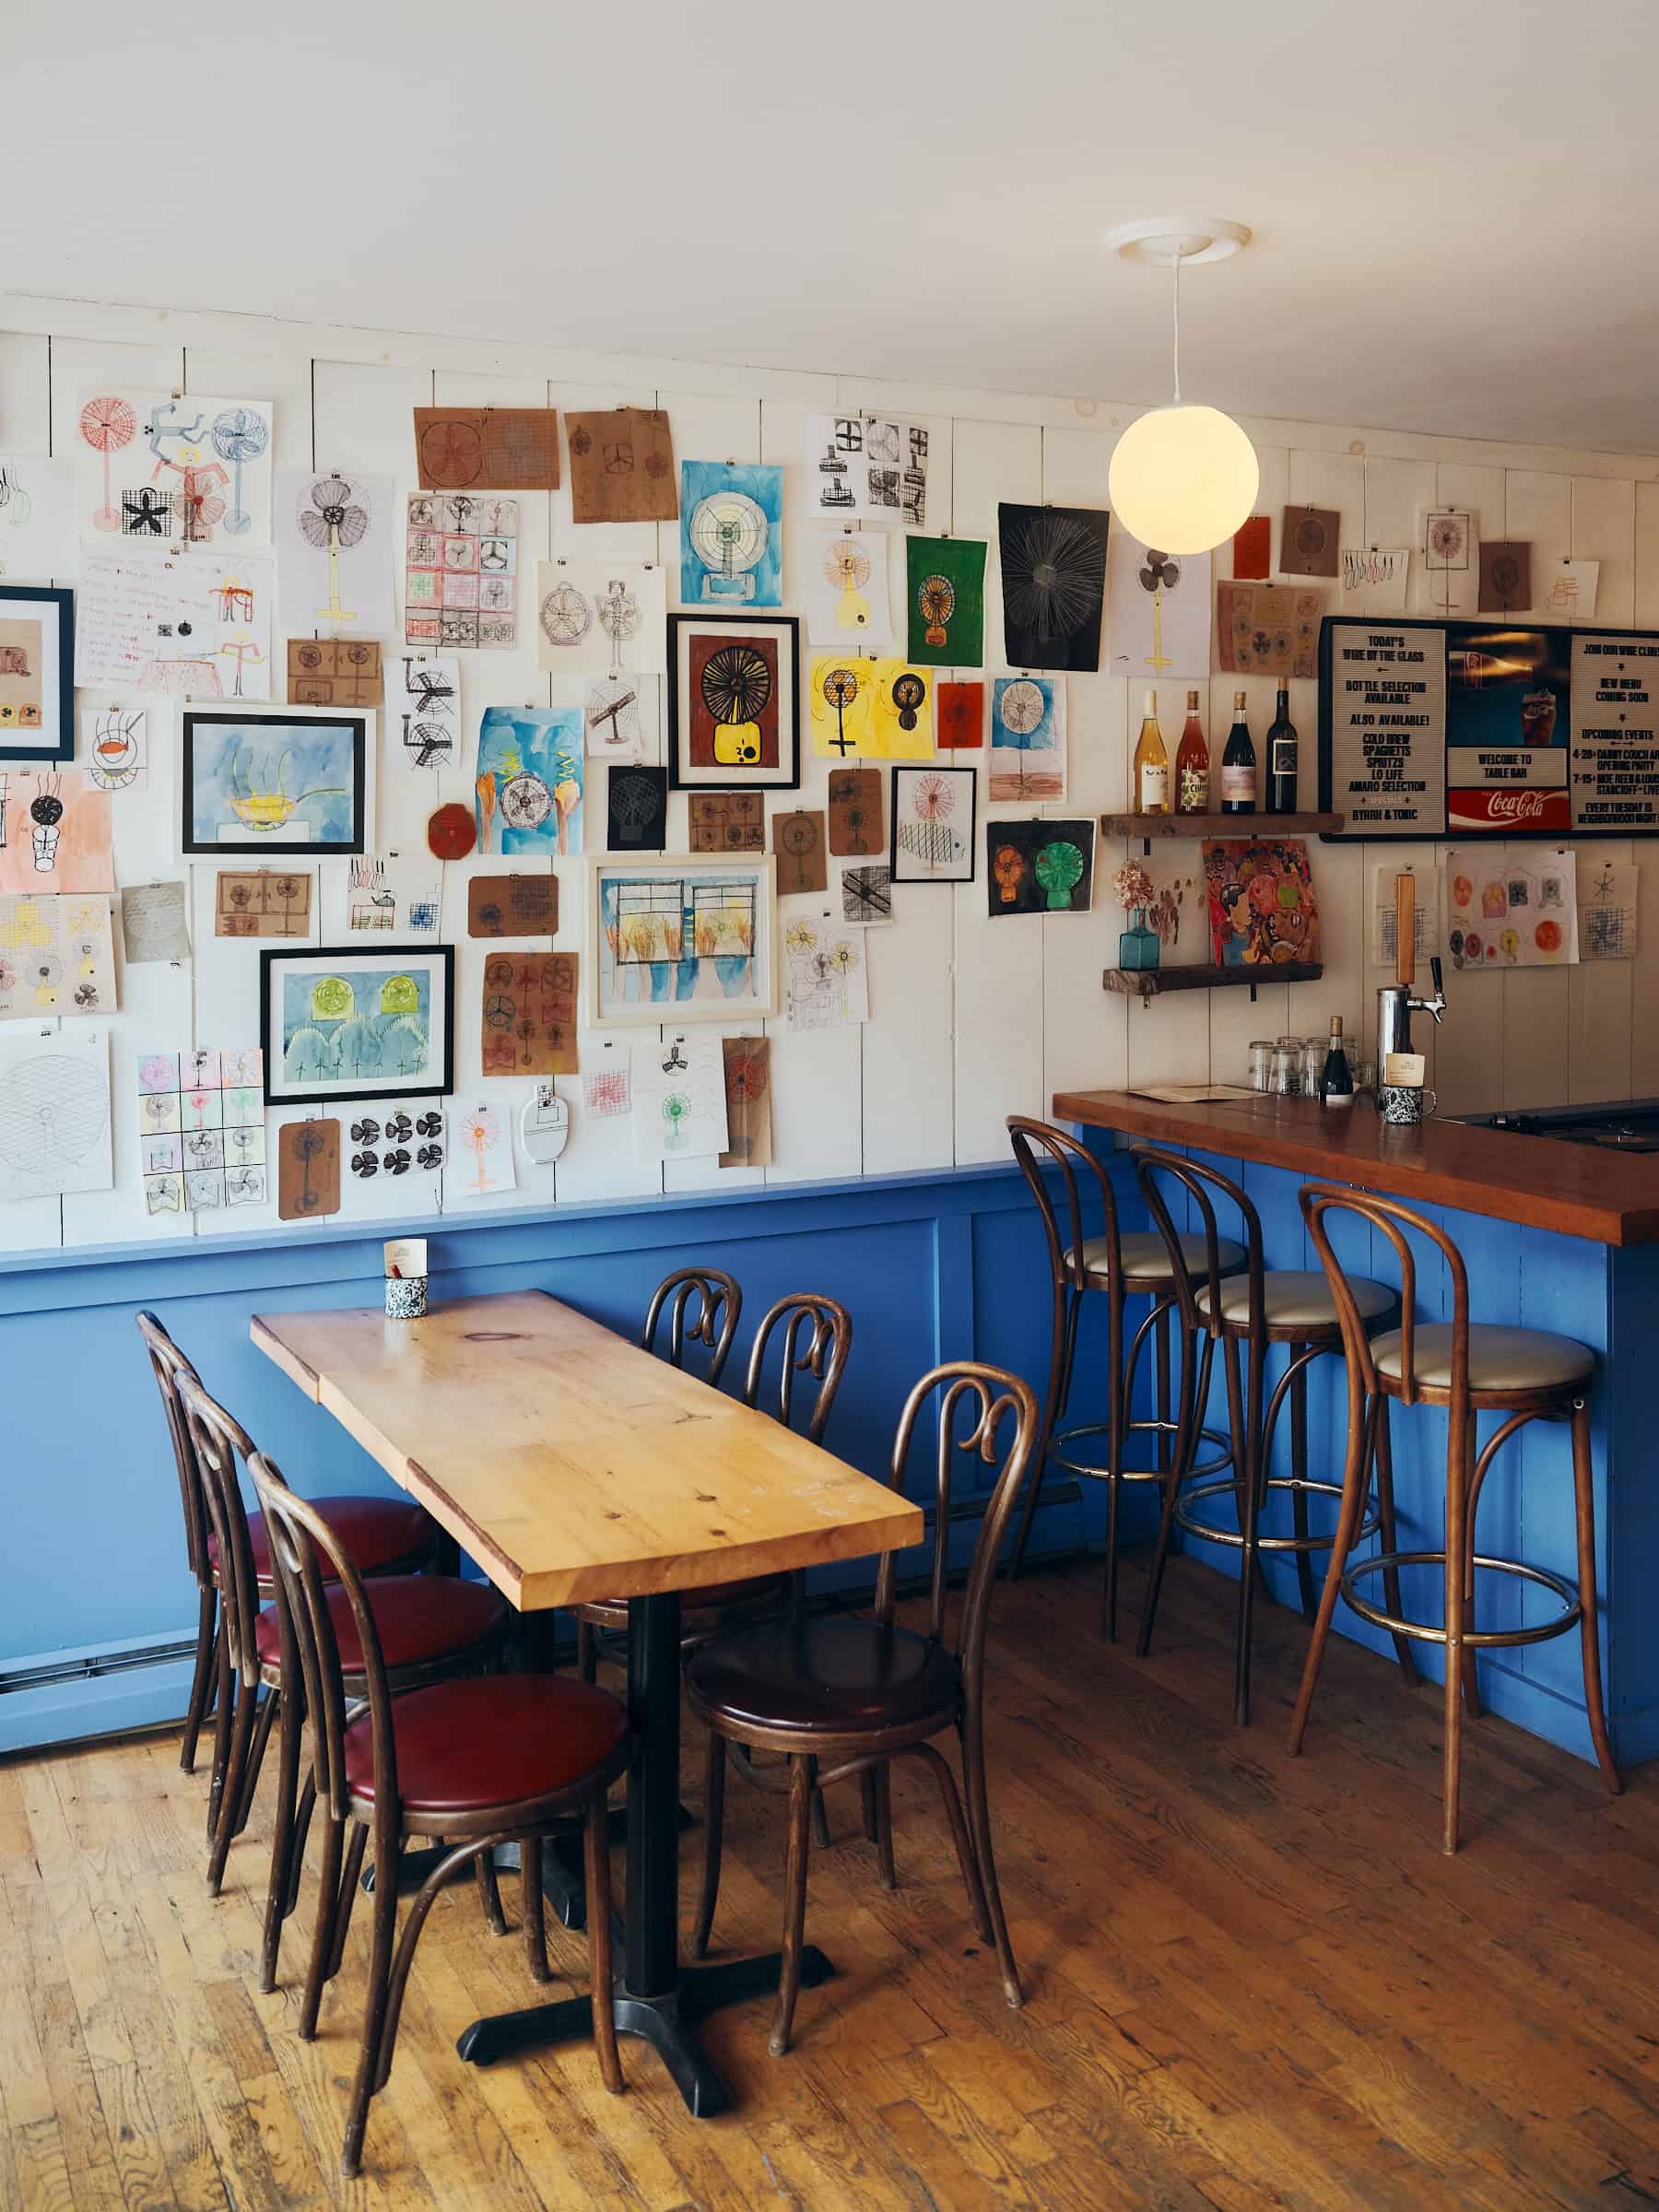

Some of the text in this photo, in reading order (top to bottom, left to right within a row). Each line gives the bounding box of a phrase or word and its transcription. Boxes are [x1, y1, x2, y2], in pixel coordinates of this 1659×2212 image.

[1368, 635, 1405, 647] TODAY'S
[1342, 649, 1424, 663] WINE BY THE GLASS
[1346, 680, 1426, 693] BOTTLE SELECTION
[1601, 677, 1618, 688] NEW
[1364, 692, 1411, 704] AVAILABLE
[1595, 691, 1649, 703] COMING SOON
[1349, 713, 1430, 726] ALSO AVAILABLE!
[1362, 734, 1410, 745] COLD BREW
[1582, 729, 1653, 740] UPCOMING EVENTS
[1477, 753, 1532, 765] WELCOME TO
[1632, 761, 1654, 771] PARTY
[1371, 769, 1404, 780] LO LIFE
[1484, 768, 1527, 779] TABLE BAR
[1349, 781, 1426, 793] AMARO SELECTION
[1585, 802, 1608, 813] EVERY
[1609, 802, 1642, 813] TUESDAY
[1384, 809, 1391, 820] &
[1393, 808, 1418, 820] TONIC
